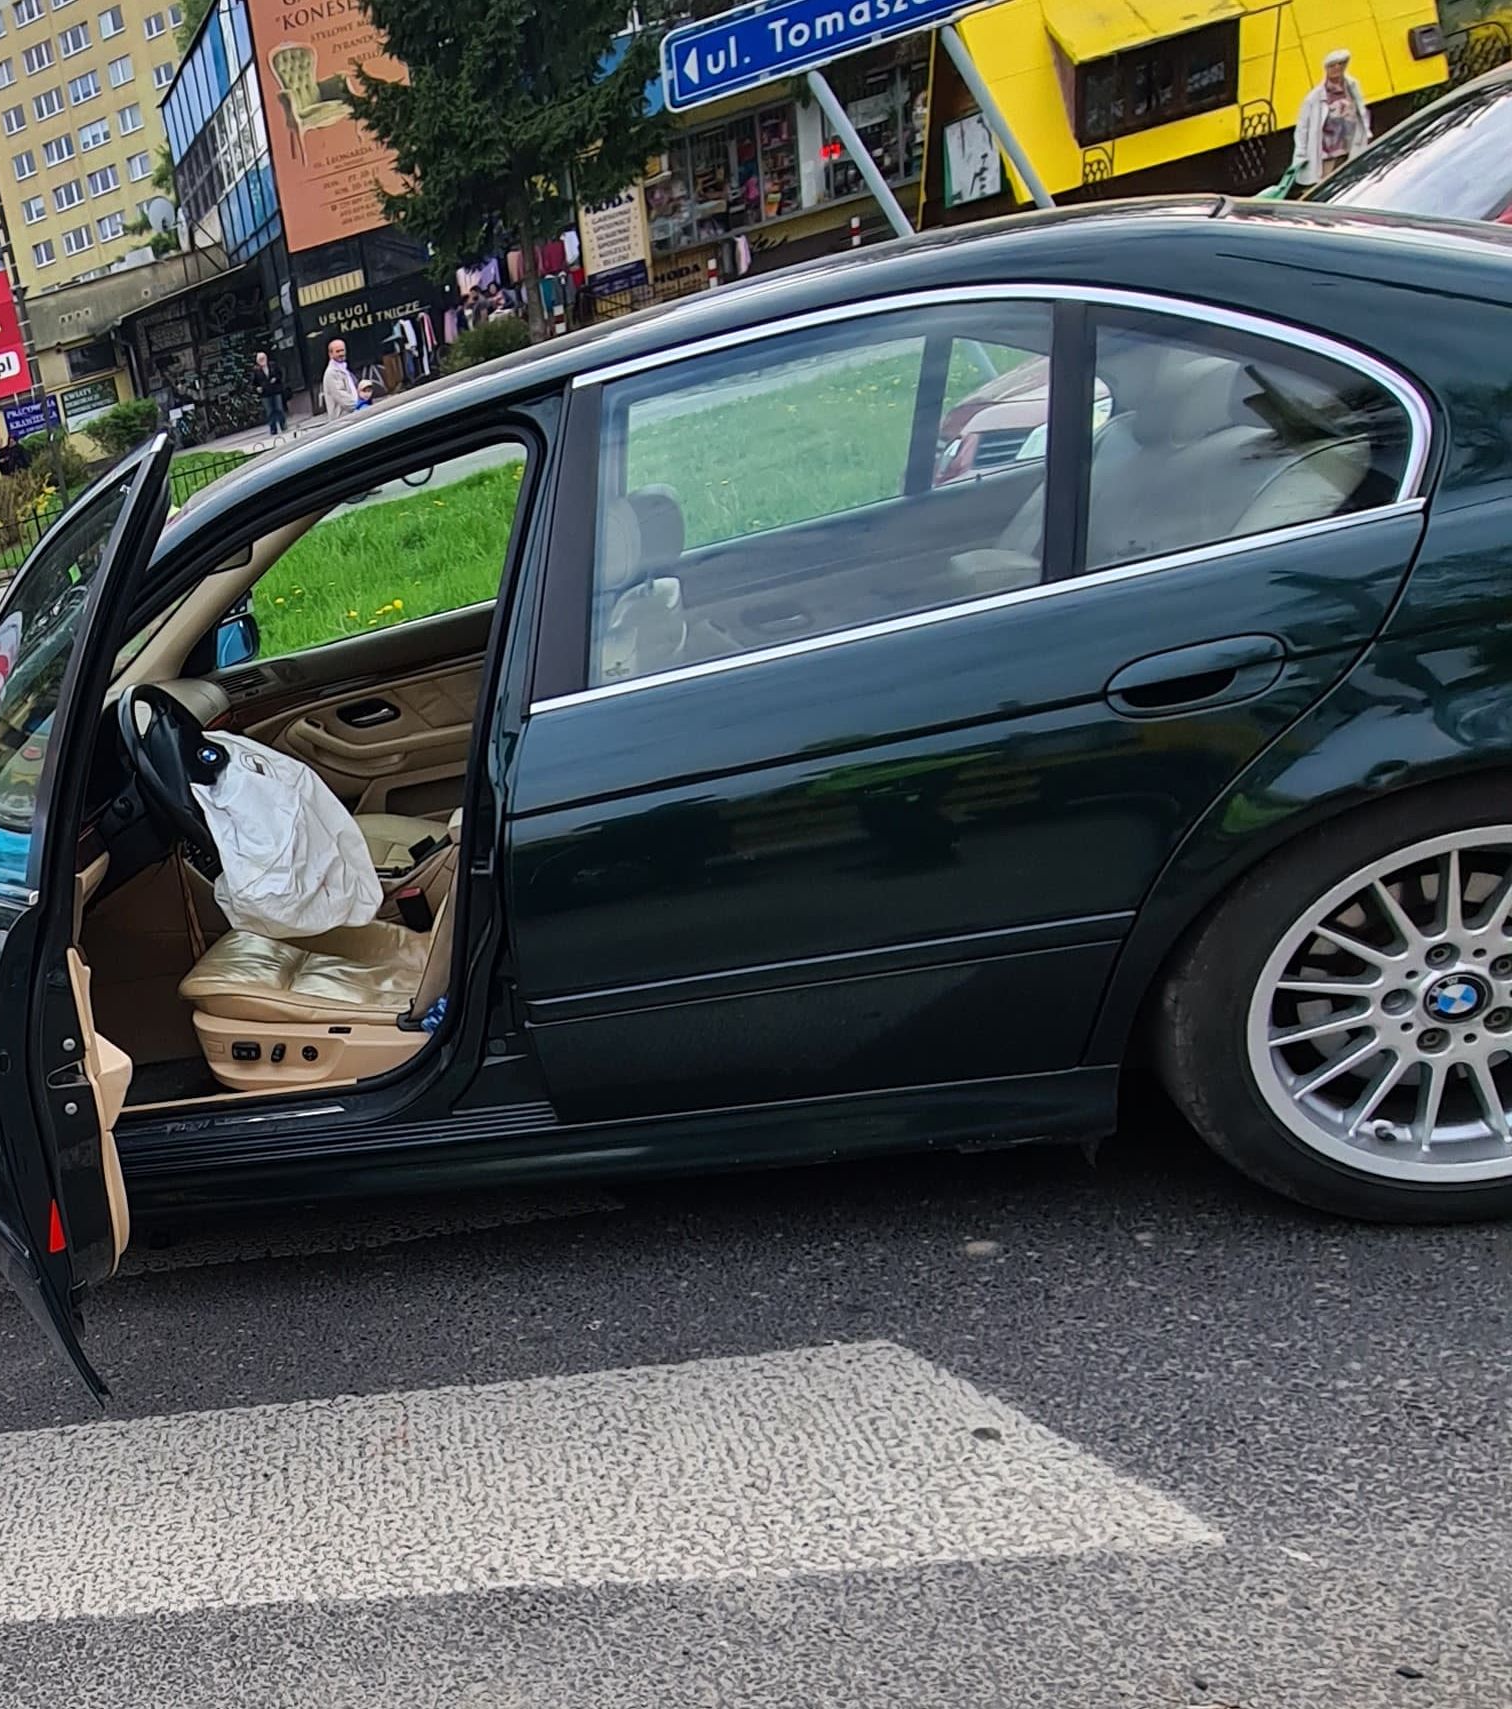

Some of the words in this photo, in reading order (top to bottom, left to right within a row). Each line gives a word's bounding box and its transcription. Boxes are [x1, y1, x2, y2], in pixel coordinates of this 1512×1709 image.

[706, 36, 751, 74] ul.
[768, 0, 929, 52] Tomasz
[318, 302, 369, 327] USŁUGI
